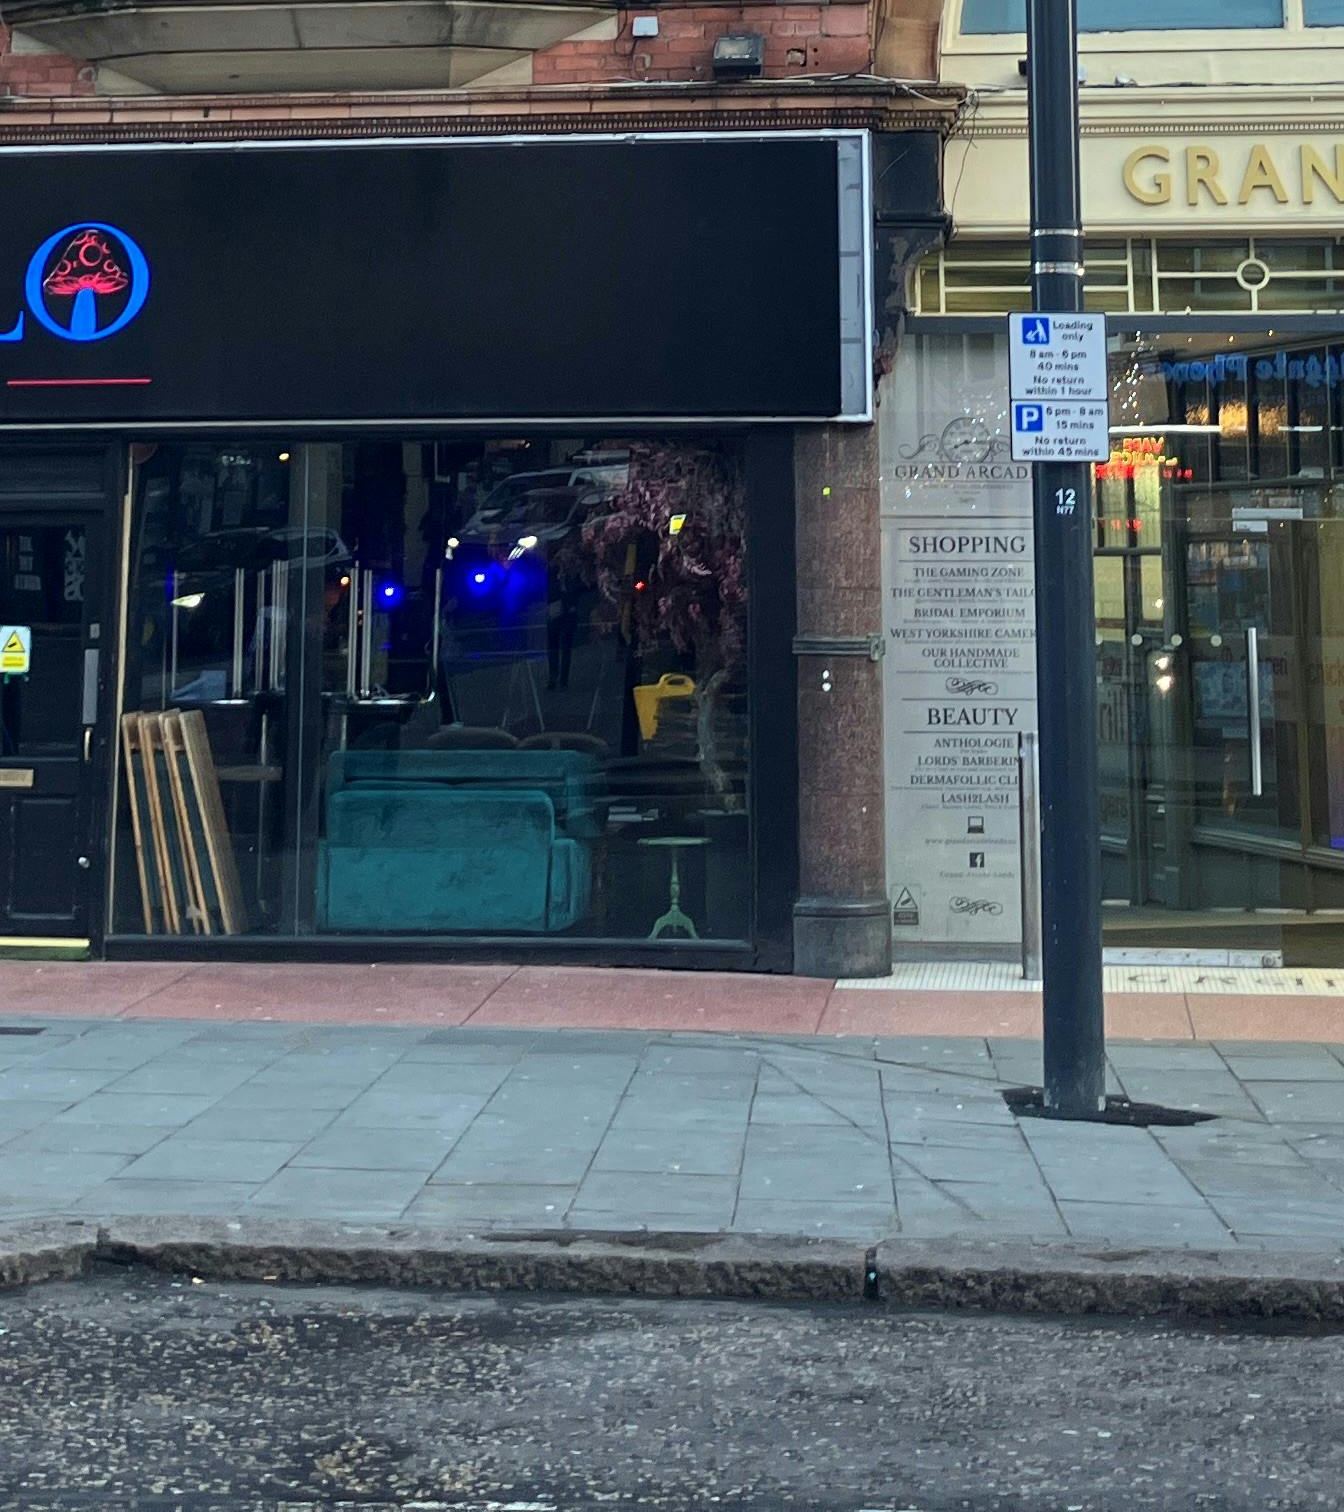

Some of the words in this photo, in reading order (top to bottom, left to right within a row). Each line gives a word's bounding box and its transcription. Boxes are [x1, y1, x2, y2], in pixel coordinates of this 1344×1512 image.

[1052, 321, 1093, 330] Loading
[1062, 332, 1084, 342] only
[1030, 350, 1036, 359] 8
[1038, 351, 1054, 359] am
[1062, 350, 1069, 359] 6
[1071, 351, 1087, 361] pm
[1037, 361, 1053, 370] 40
[1055, 361, 1079, 370] mins
[1033, 375, 1049, 384] No
[1052, 376, 1085, 384] return
[1025, 387, 1057, 395] within
[1061, 387, 1065, 395] 1
[1068, 387, 1092, 395] hour
[1055, 408, 1071, 417] pm
[1080, 407, 1086, 416] 8
[1088, 408, 1104, 416] am
[1056, 420, 1067, 429] 15
[1070, 420, 1094, 429] mins
[1035, 436, 1050, 445] No
[1053, 436, 1086, 445] return
[1022, 447, 1054, 456] within
[1057, 447, 1073, 456] 45
[1074, 447, 1099, 456] mins
[894, 465, 960, 480] GRAND
[966, 465, 1033, 480] ARCAD
[1056, 488, 1076, 505] 12
[1056, 505, 1075, 514] N77
[908, 536, 1026, 554] SHOPPING
[913, 567, 938, 578] THE
[939, 567, 989, 578] GAMING
[991, 567, 1024, 578] ZONE
[891, 588, 916, 598] THE
[917, 588, 1002, 599] GENTLEMAN'S
[913, 608, 956, 618] BRIDAL
[960, 607, 1026, 618] EMPORIUM
[890, 628, 923, 639] WEST
[923, 628, 992, 639] YORKSHIRE
[922, 648, 948, 658] OUR
[950, 647, 1020, 658] HANDMADE
[934, 658, 1009, 668] COLLECTIVE
[927, 707, 1018, 726] BEAUTY
[934, 738, 1015, 749] ANTHOLOGIE
[910, 775, 996, 786] DERMAFOLLIC
[941, 793, 1010, 804] LASH2LASH
